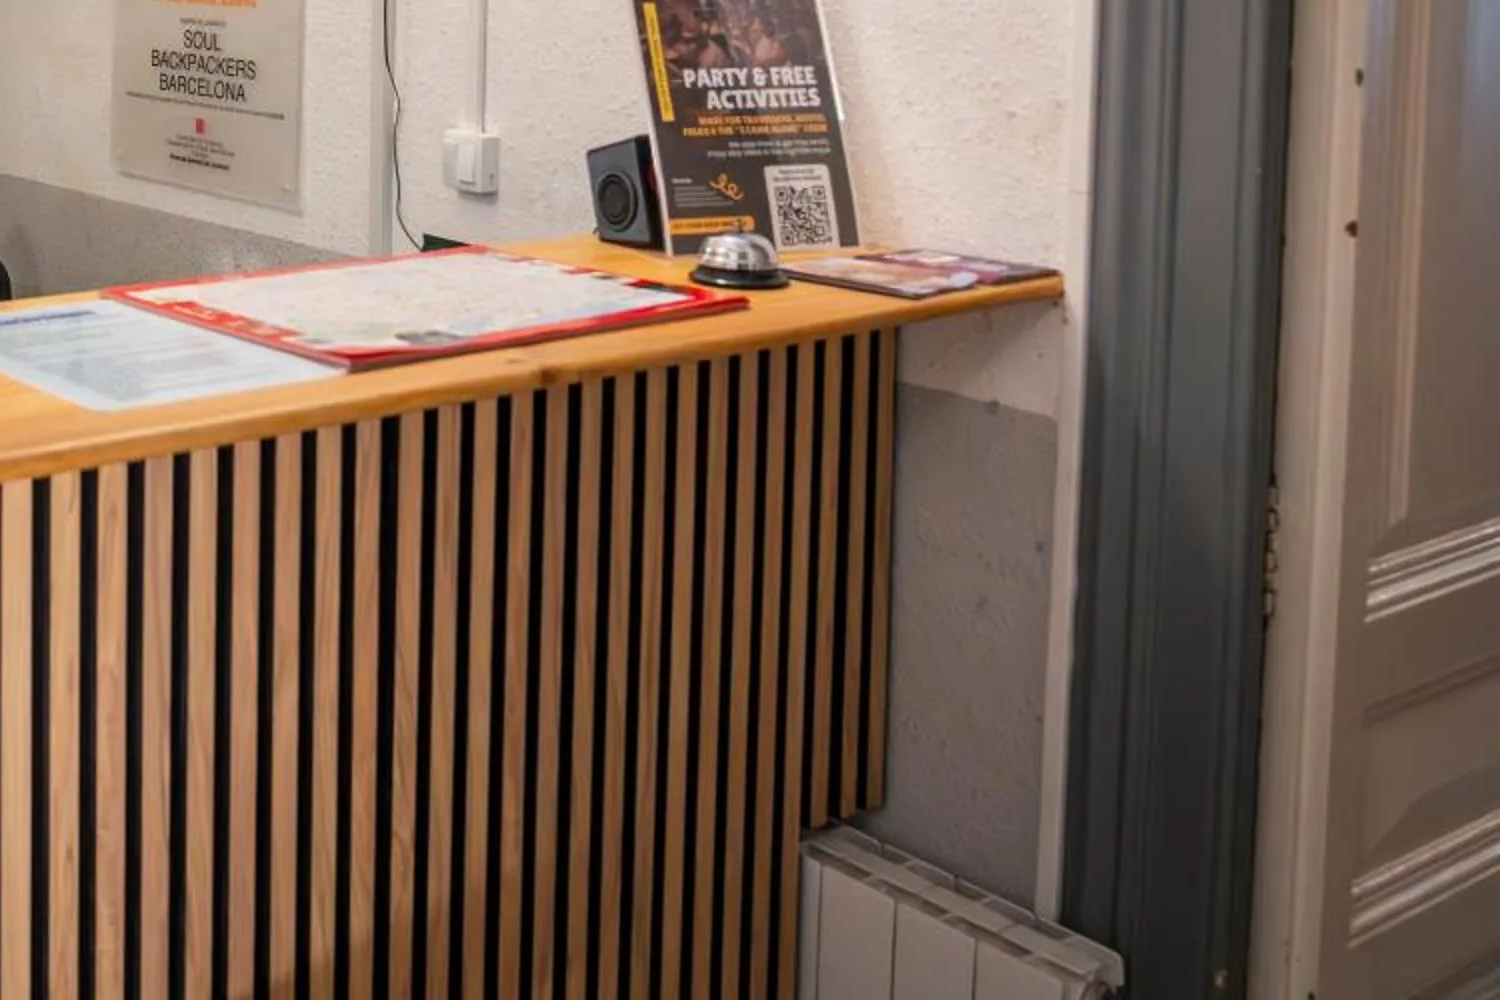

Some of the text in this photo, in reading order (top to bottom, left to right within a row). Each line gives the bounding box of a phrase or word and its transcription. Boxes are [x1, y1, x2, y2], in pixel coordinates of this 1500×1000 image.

[183, 29, 222, 51] SOUL
[151, 49, 256, 80] BACKPACKERS
[159, 74, 246, 102] BARCELONA
[682, 65, 817, 88] PARTY & FREE
[707, 87, 821, 110] ACTIVITIES
